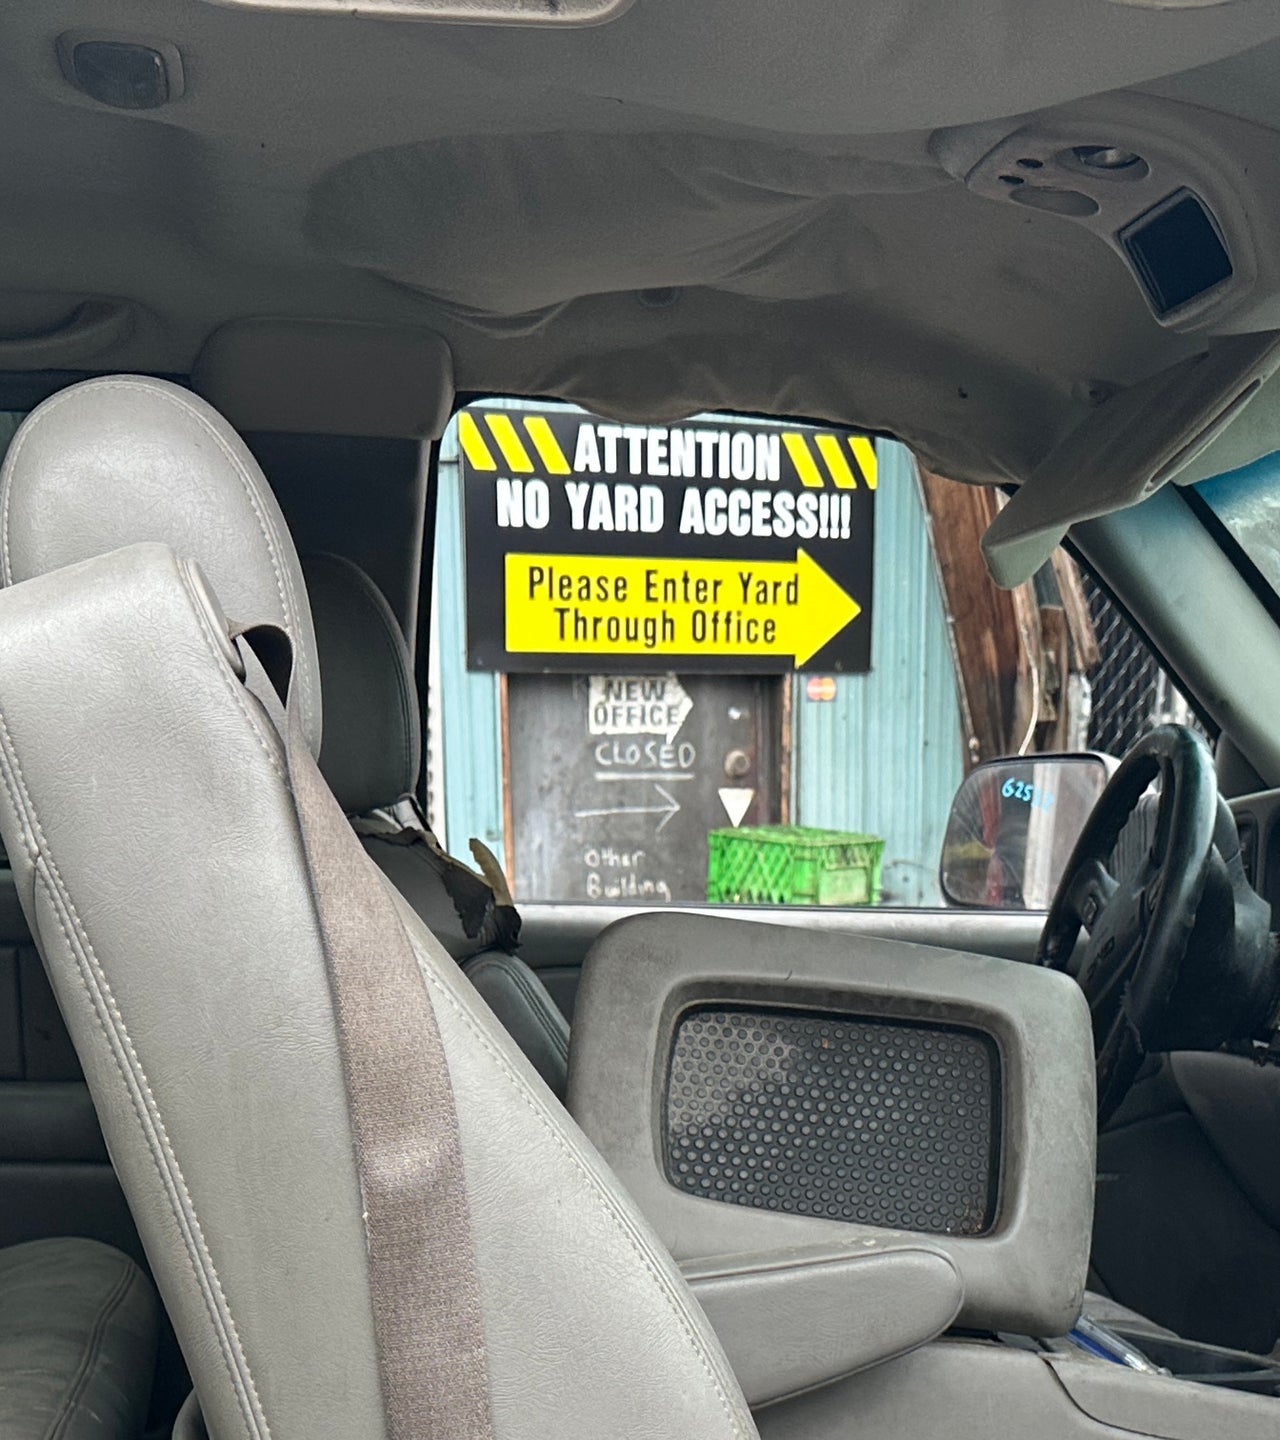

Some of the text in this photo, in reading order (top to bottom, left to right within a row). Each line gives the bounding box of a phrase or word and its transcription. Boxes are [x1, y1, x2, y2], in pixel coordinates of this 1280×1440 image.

[573, 423, 781, 482] ATTENTION
[495, 478, 852, 540] NO YARD ACCESS!!!
[528, 566, 799, 605] Please Enter Yard
[553, 606, 777, 648] Through Office
[605, 680, 666, 702] NEW
[594, 701, 680, 727] OFFICE
[595, 740, 696, 768] CLOSED
[586, 871, 671, 903] Building
